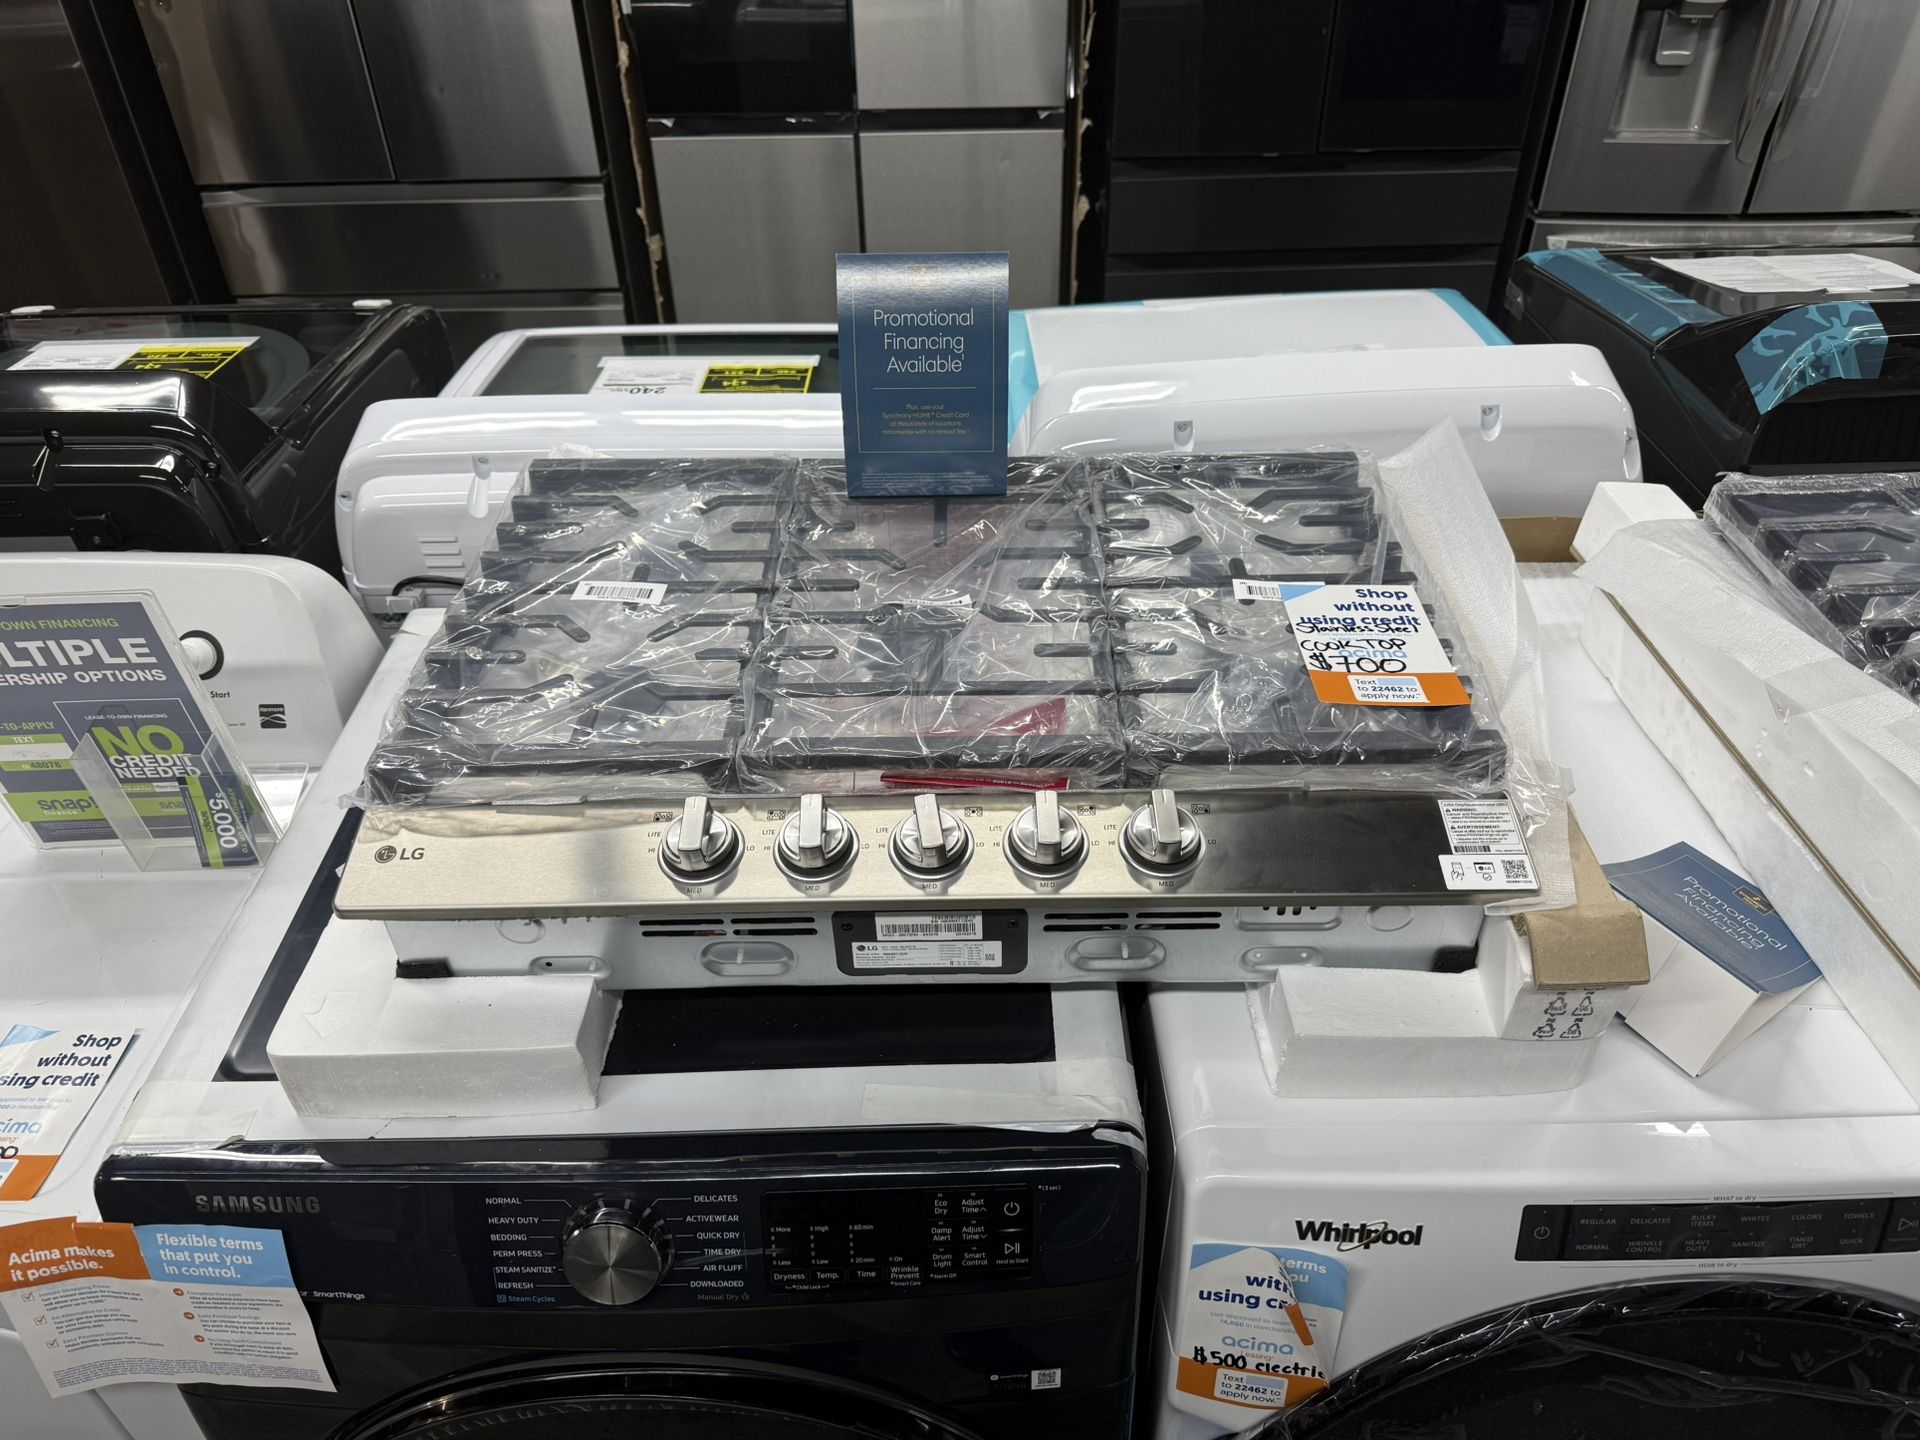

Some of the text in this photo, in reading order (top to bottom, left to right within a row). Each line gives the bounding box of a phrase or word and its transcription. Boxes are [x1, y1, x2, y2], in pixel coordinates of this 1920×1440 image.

[874, 308, 974, 326] Promotional
[884, 333, 964, 354] Financing
[1355, 588, 1408, 600] Shop
[1334, 602, 1414, 612] without
[38, 618, 120, 629] FINANCING
[1300, 615, 1421, 628] using credit
[0, 638, 158, 668] LTIPLE
[1309, 652, 1407, 673] $700
[74, 669, 167, 683] OPTIONS
[12, 736, 34, 744] TEXT
[91, 725, 185, 757] NO
[30, 761, 62, 769] 48078
[109, 753, 193, 768] CREDIT
[114, 766, 202, 779] NEEDED
[37, 795, 101, 812] snap!
[209, 792, 239, 848] $5,000
[400, 848, 425, 860] LG
[1683, 875, 1788, 951] Promotional
[1681, 887, 1766, 951] Financing
[72, 1034, 122, 1050] Shop
[37, 1053, 112, 1067] without
[41, 1072, 101, 1087] credit
[485, 1197, 522, 1205] NORMAL
[694, 1194, 738, 1202] DELICATES
[934, 1199, 947, 1207] Eco
[961, 1198, 985, 1206] Adjust
[1744, 1194, 1757, 1202] dry
[195, 1195, 321, 1214] SAMSUNG
[934, 1207, 948, 1216] Dry
[488, 1216, 539, 1225] HEAVY DUTY
[685, 1214, 739, 1222] ACTIVEWEAR
[1580, 1218, 1617, 1226] REGULAR
[1630, 1217, 1671, 1225] DELICATES
[1741, 1215, 1771, 1223] WHITES
[1792, 1213, 1822, 1221] COLORS
[815, 1225, 829, 1233] High
[931, 1226, 952, 1235] Damp
[961, 1225, 985, 1234] Adjust
[490, 1233, 528, 1241] BEDDING
[696, 1231, 740, 1240] QUICK DRY
[1295, 1219, 1423, 1251] Whirlpool
[156, 1232, 264, 1252] Flexible terms
[1839, 1237, 1863, 1245] QUICK
[704, 1248, 742, 1256] TIME DRY
[1575, 1243, 1610, 1251] NORMAL
[1625, 1246, 1662, 1254] CONTROL
[8, 1246, 115, 1266] Acima makes
[160, 1248, 253, 1268] that put you
[493, 1250, 543, 1258] PERM PRESS
[964, 1251, 986, 1259] Smart
[933, 1260, 952, 1268] Light
[961, 1258, 988, 1266] Control
[1725, 1261, 1738, 1270] dry
[10, 1259, 104, 1282] it possible.
[164, 1262, 241, 1279] in control.
[495, 1266, 520, 1274] STEAM
[703, 1264, 743, 1272] AIR FLUFF
[890, 1265, 919, 1273] Wrinkle
[773, 1272, 805, 1282] Dryness
[816, 1271, 840, 1281] Temp.
[856, 1270, 876, 1278] Time
[890, 1272, 920, 1280] Prevent
[1288, 1272, 1309, 1283] ou
[498, 1281, 534, 1289] REFRESH
[690, 1279, 744, 1288] DOWNLOADED
[313, 1291, 366, 1301] SmartThings
[508, 1294, 555, 1303] Steam Cycles
[697, 1292, 723, 1301] Manual
[1198, 1289, 1260, 1309] using
[1221, 1335, 1294, 1355] acima
[1192, 1345, 1247, 1369] $500
[1240, 1350, 1273, 1362] Leasing
[1222, 1373, 1244, 1383] Text
[1221, 1381, 1281, 1396] to 22462 to
[1220, 1390, 1249, 1402] apply
